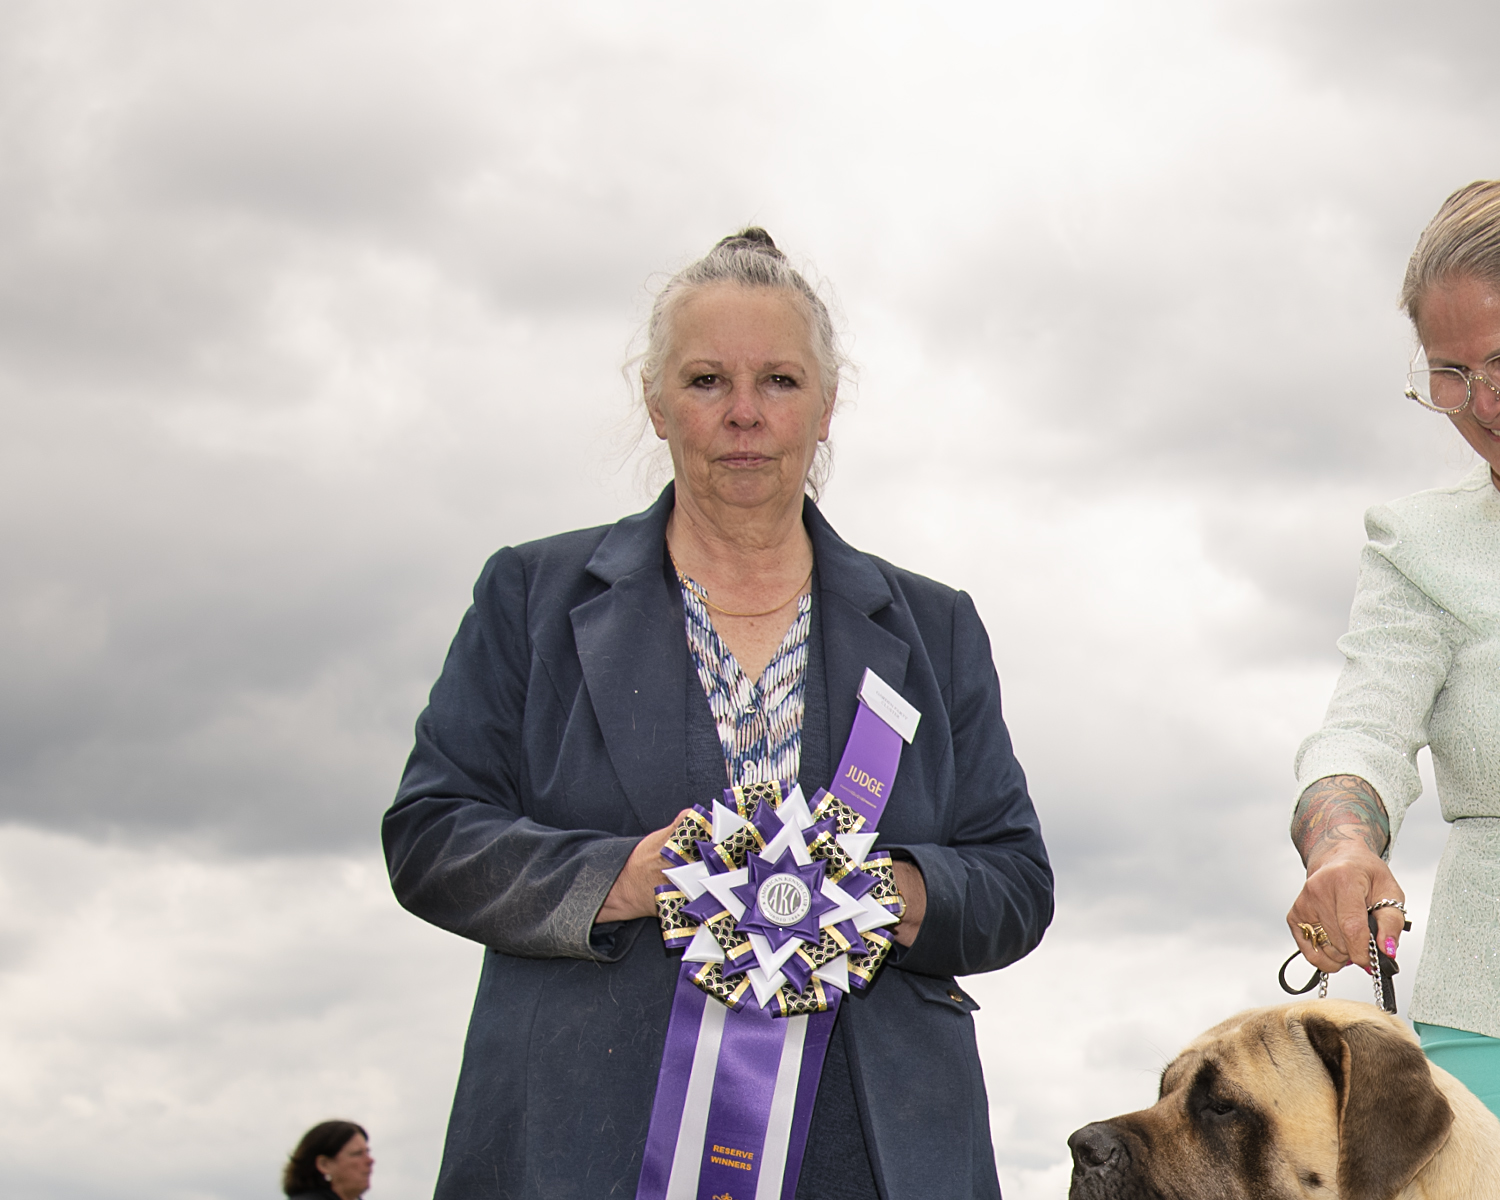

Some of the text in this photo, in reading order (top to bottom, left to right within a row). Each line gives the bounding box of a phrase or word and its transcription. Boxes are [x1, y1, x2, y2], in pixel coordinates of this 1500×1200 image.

[845, 764, 885, 798] JUDGE
[761, 876, 783, 898] AMERICAN
[784, 876, 804, 892] KENNEL
[769, 883, 800, 915] AKC
[712, 1144, 754, 1160] RESERVE
[710, 1156, 752, 1171] WINNERS
